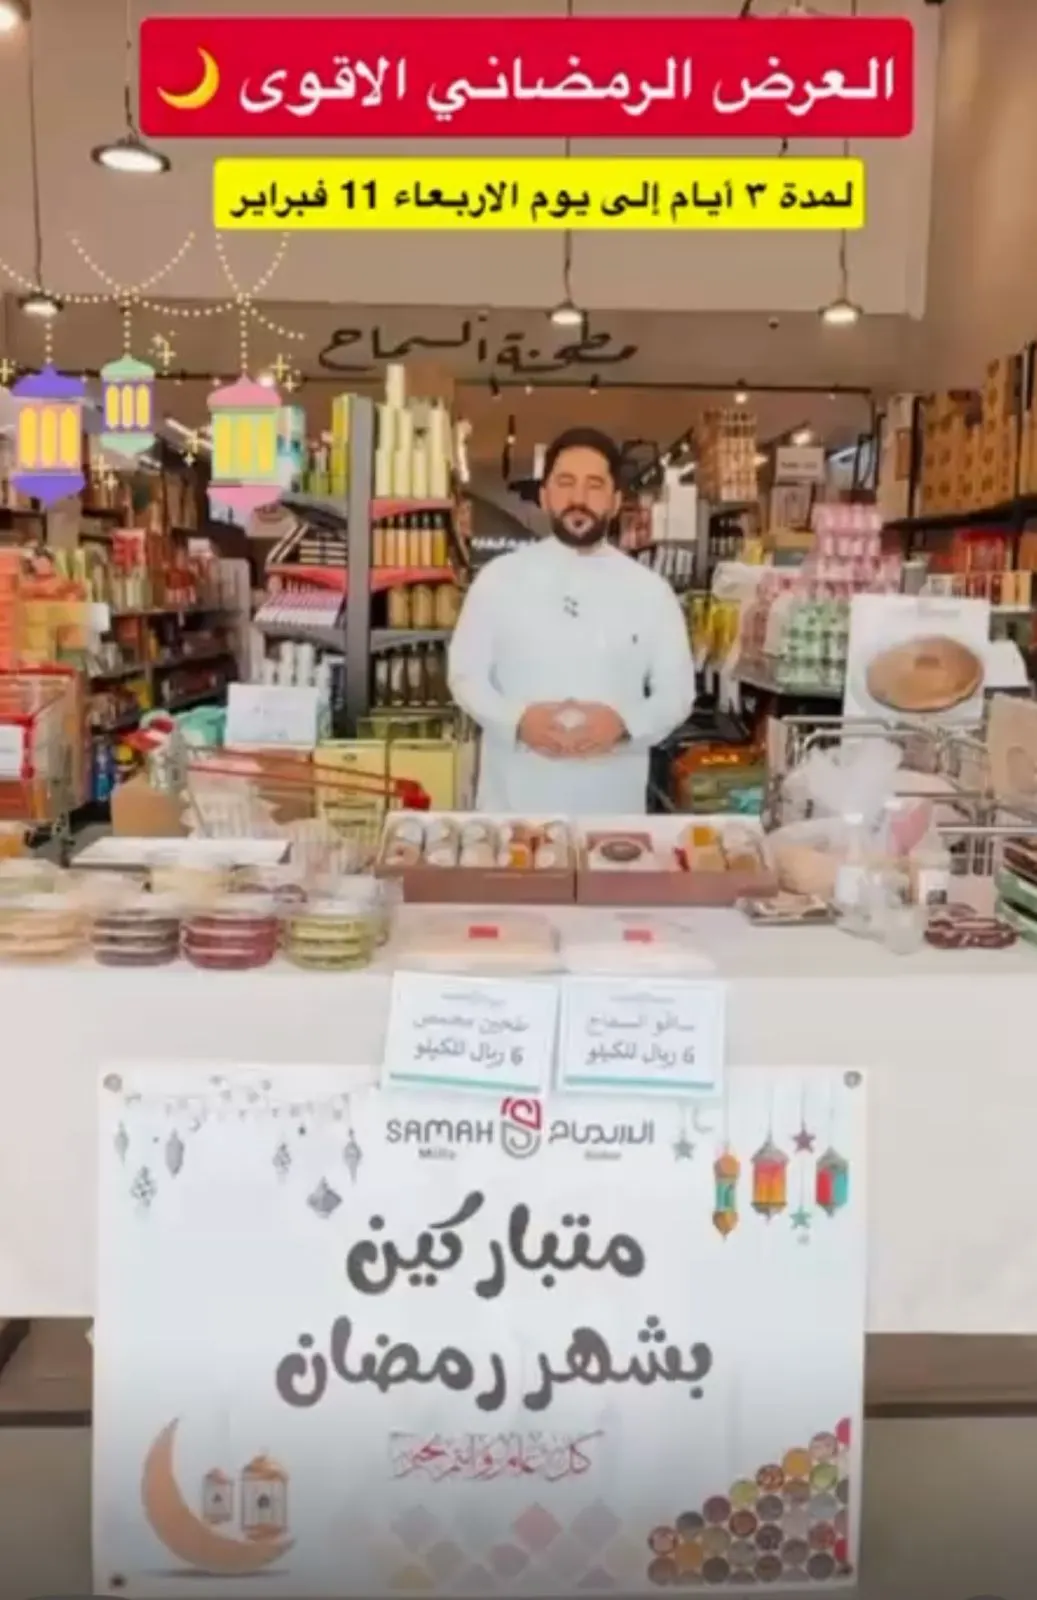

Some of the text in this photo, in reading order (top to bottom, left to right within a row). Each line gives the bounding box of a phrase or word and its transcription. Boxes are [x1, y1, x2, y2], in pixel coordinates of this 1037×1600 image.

[469, 1041, 505, 1069] ريال
[510, 1046, 524, 1066] 6
[641, 1042, 676, 1069] ريال
[386, 1119, 494, 1144] SAMAH
[275, 1315, 713, 1412] بشهر رمضان
